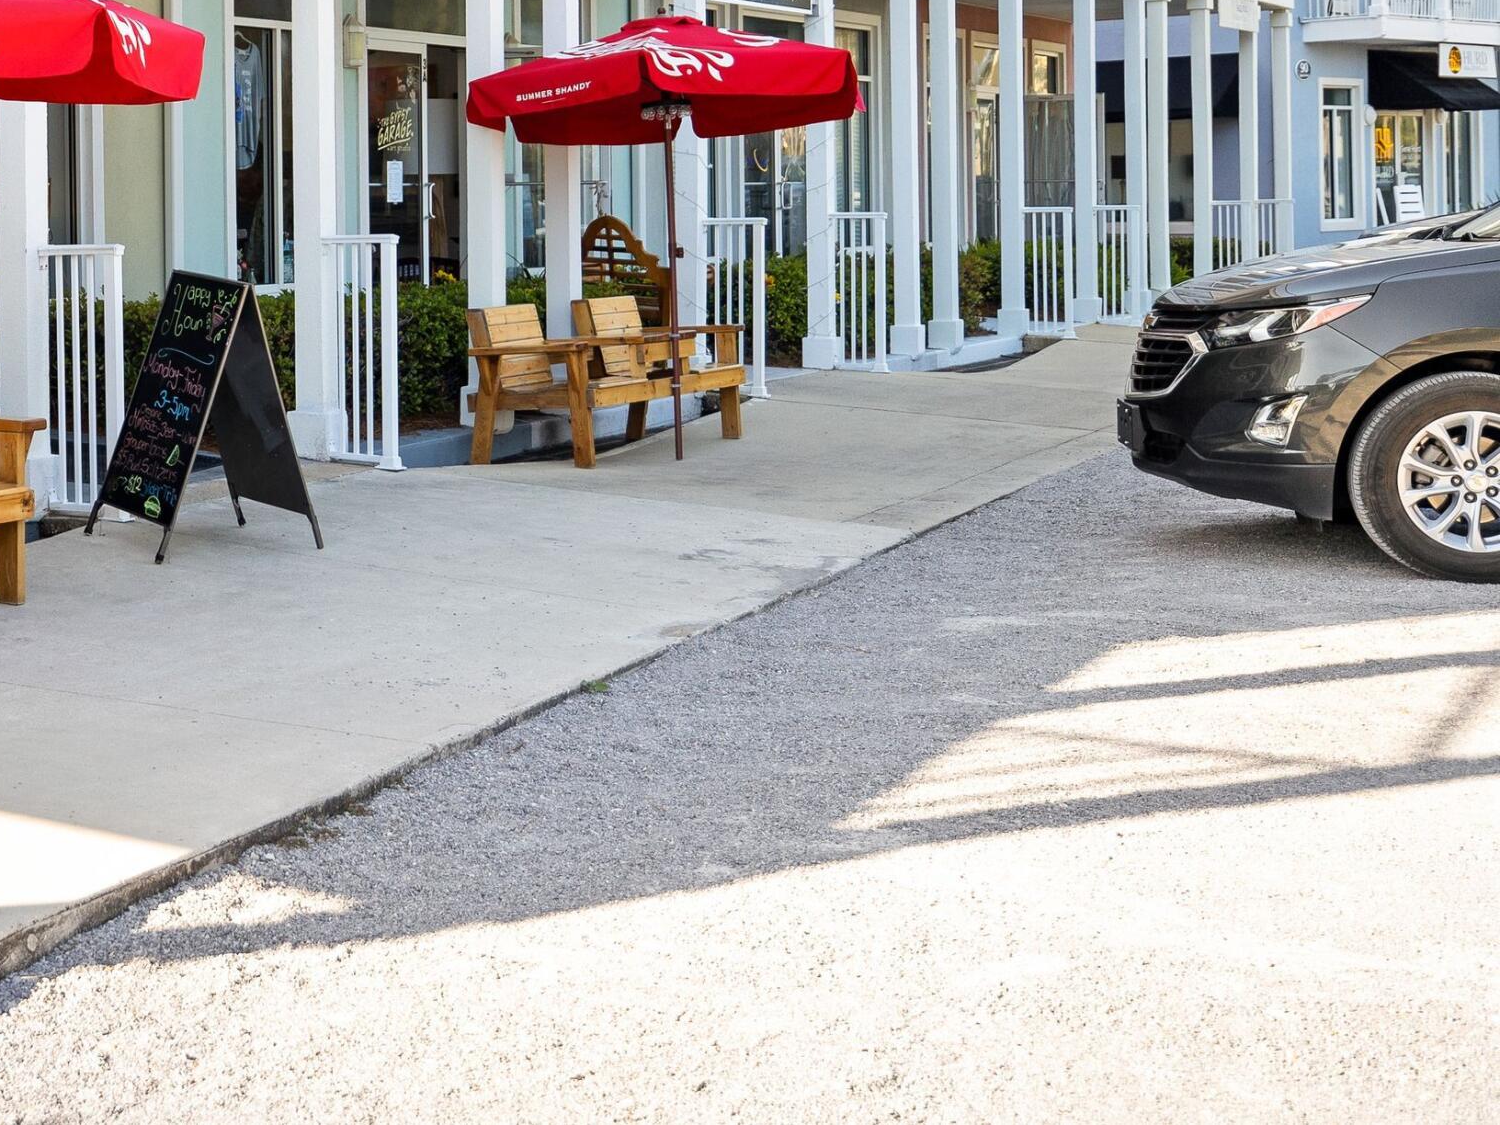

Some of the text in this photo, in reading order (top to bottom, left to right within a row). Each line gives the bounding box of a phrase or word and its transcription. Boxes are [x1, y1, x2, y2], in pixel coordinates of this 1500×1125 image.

[516, 81, 592, 102] SUMMER SHANDY
[377, 119, 413, 146] GARAGE
